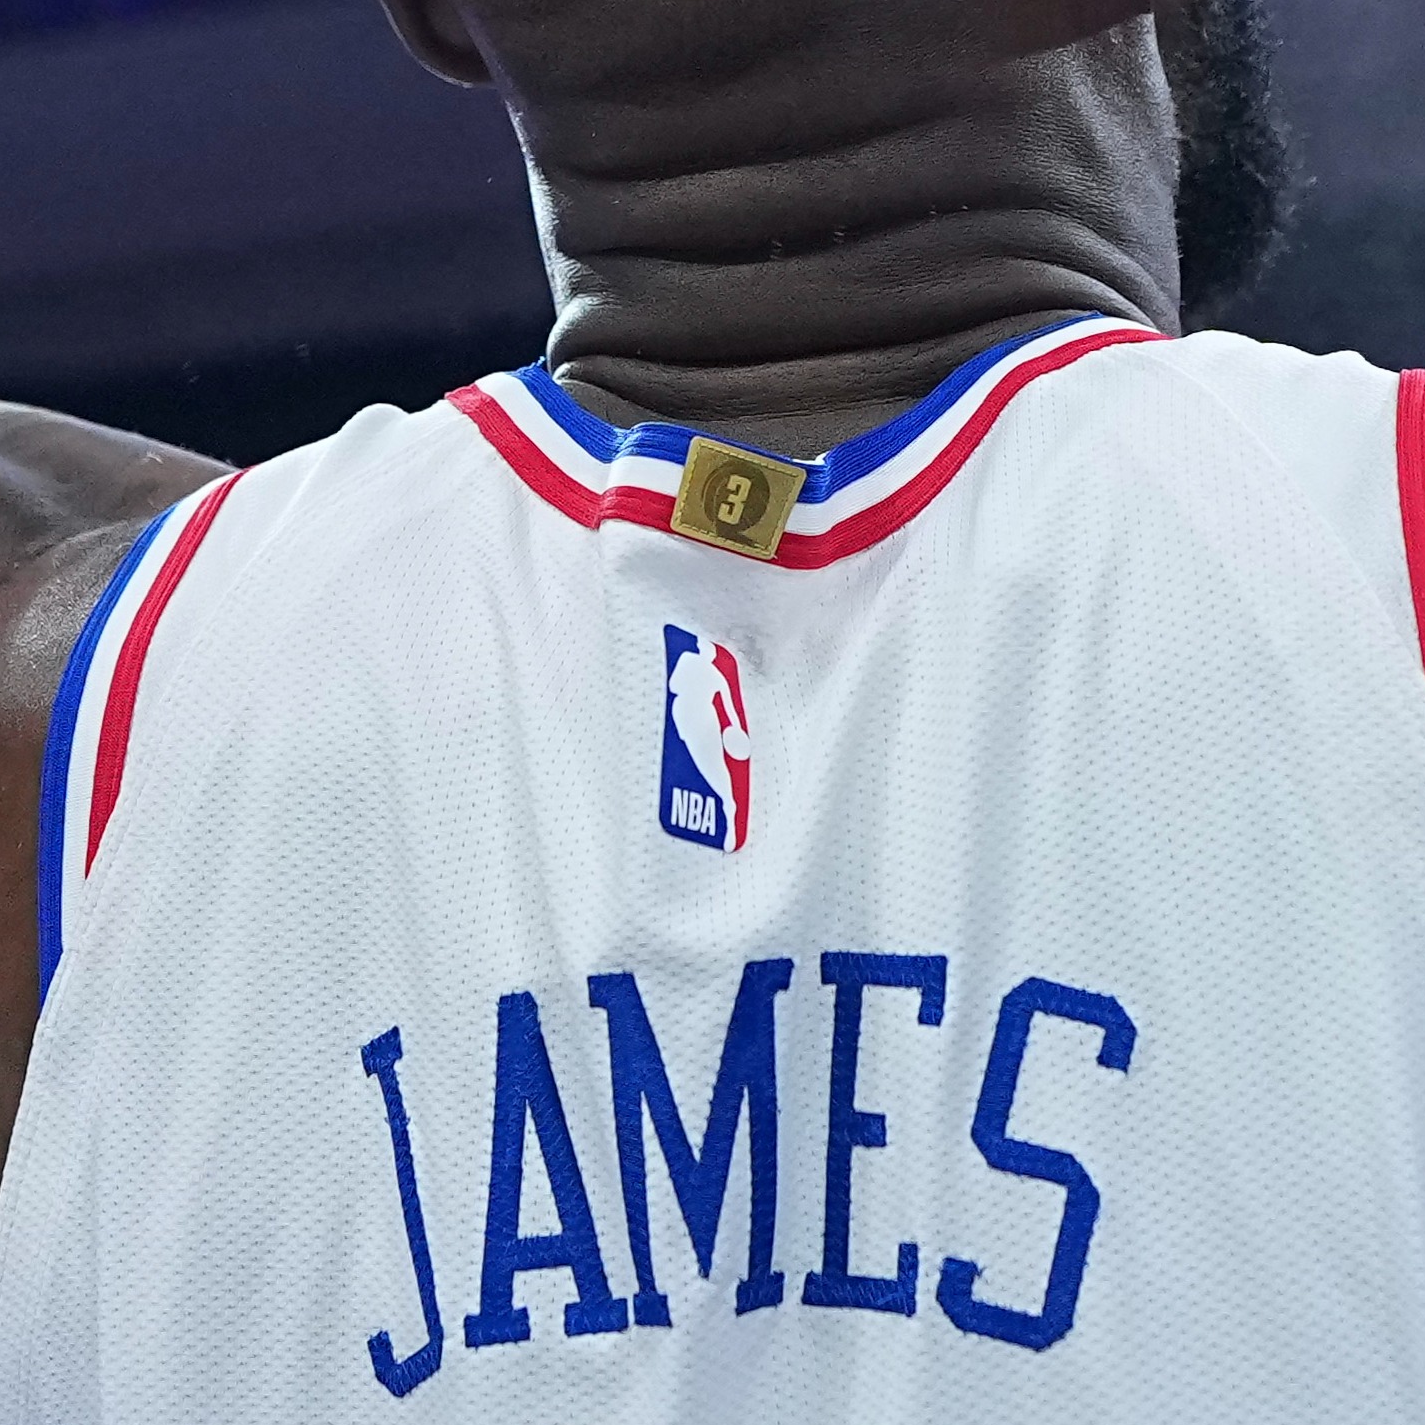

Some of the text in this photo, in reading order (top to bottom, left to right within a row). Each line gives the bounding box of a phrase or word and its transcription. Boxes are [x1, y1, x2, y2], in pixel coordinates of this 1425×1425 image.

[717, 474, 752, 525] 3
[670, 787, 716, 837] NBA
[360, 951, 1137, 1396] JAMES
